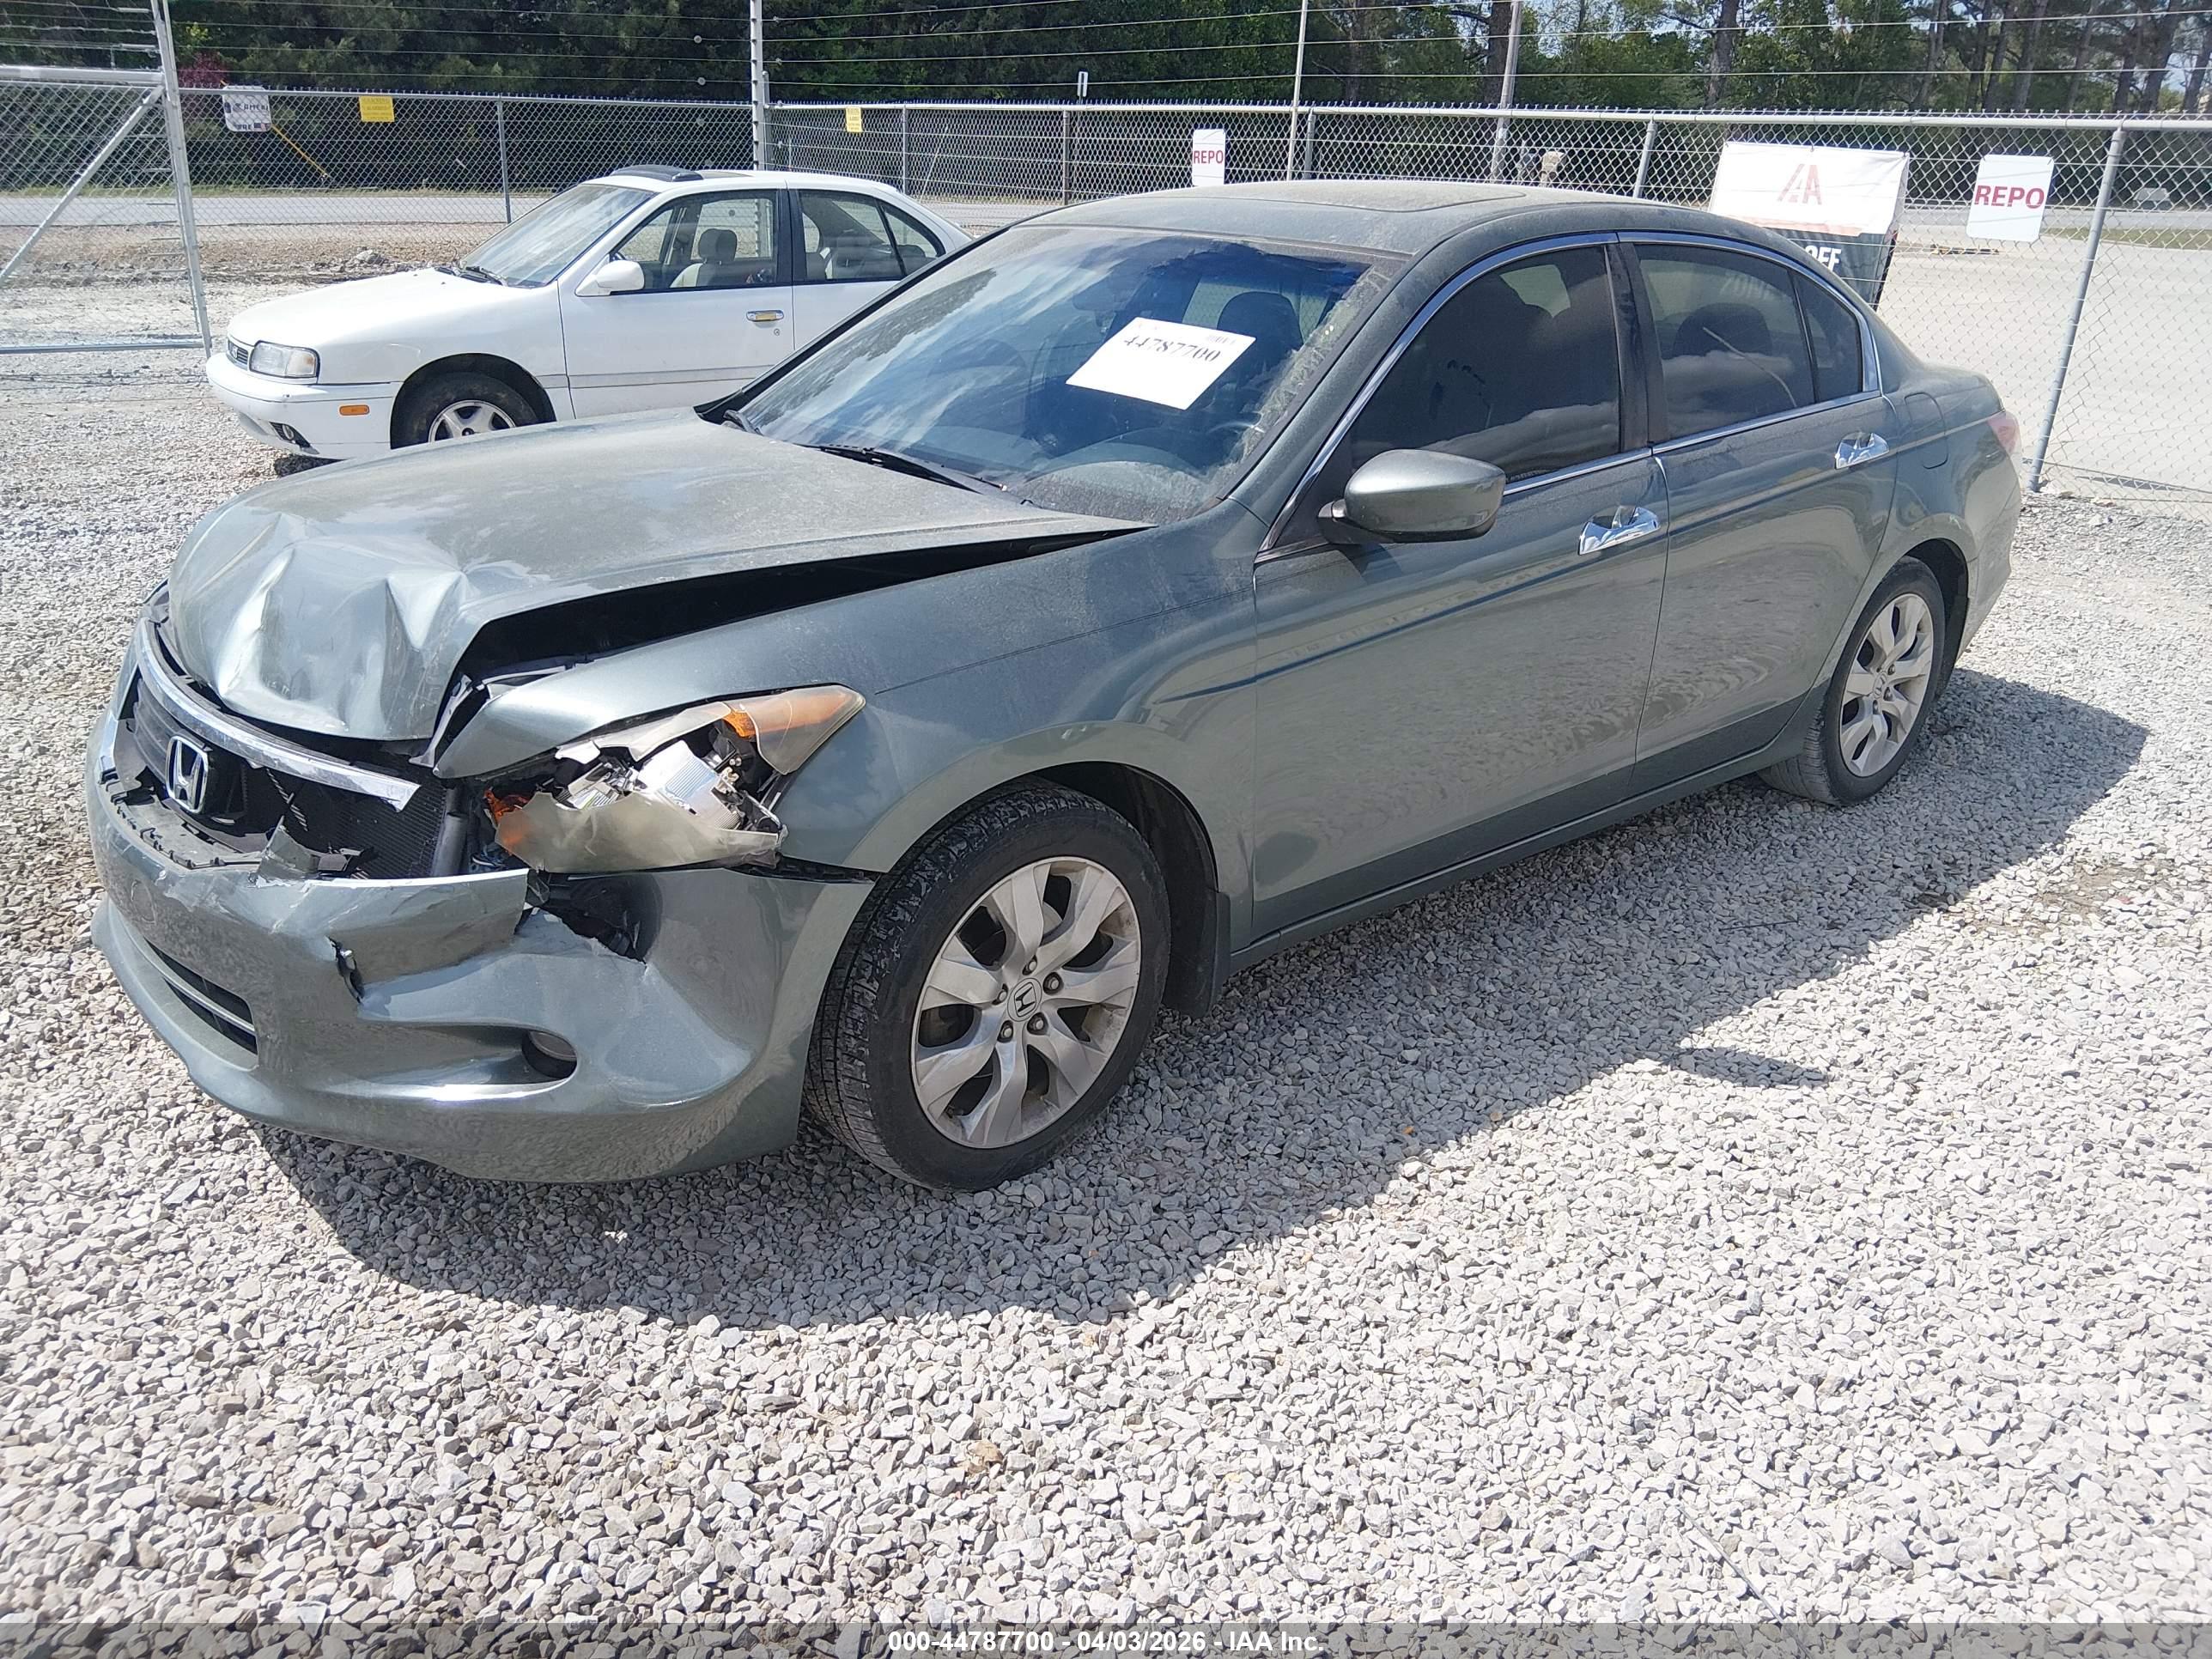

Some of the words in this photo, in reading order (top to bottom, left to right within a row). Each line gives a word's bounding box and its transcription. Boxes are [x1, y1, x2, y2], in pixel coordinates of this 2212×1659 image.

[1194, 149, 1224, 164] REPO
[1974, 185, 2045, 210] REPO
[1123, 335, 1221, 362] 44787700
